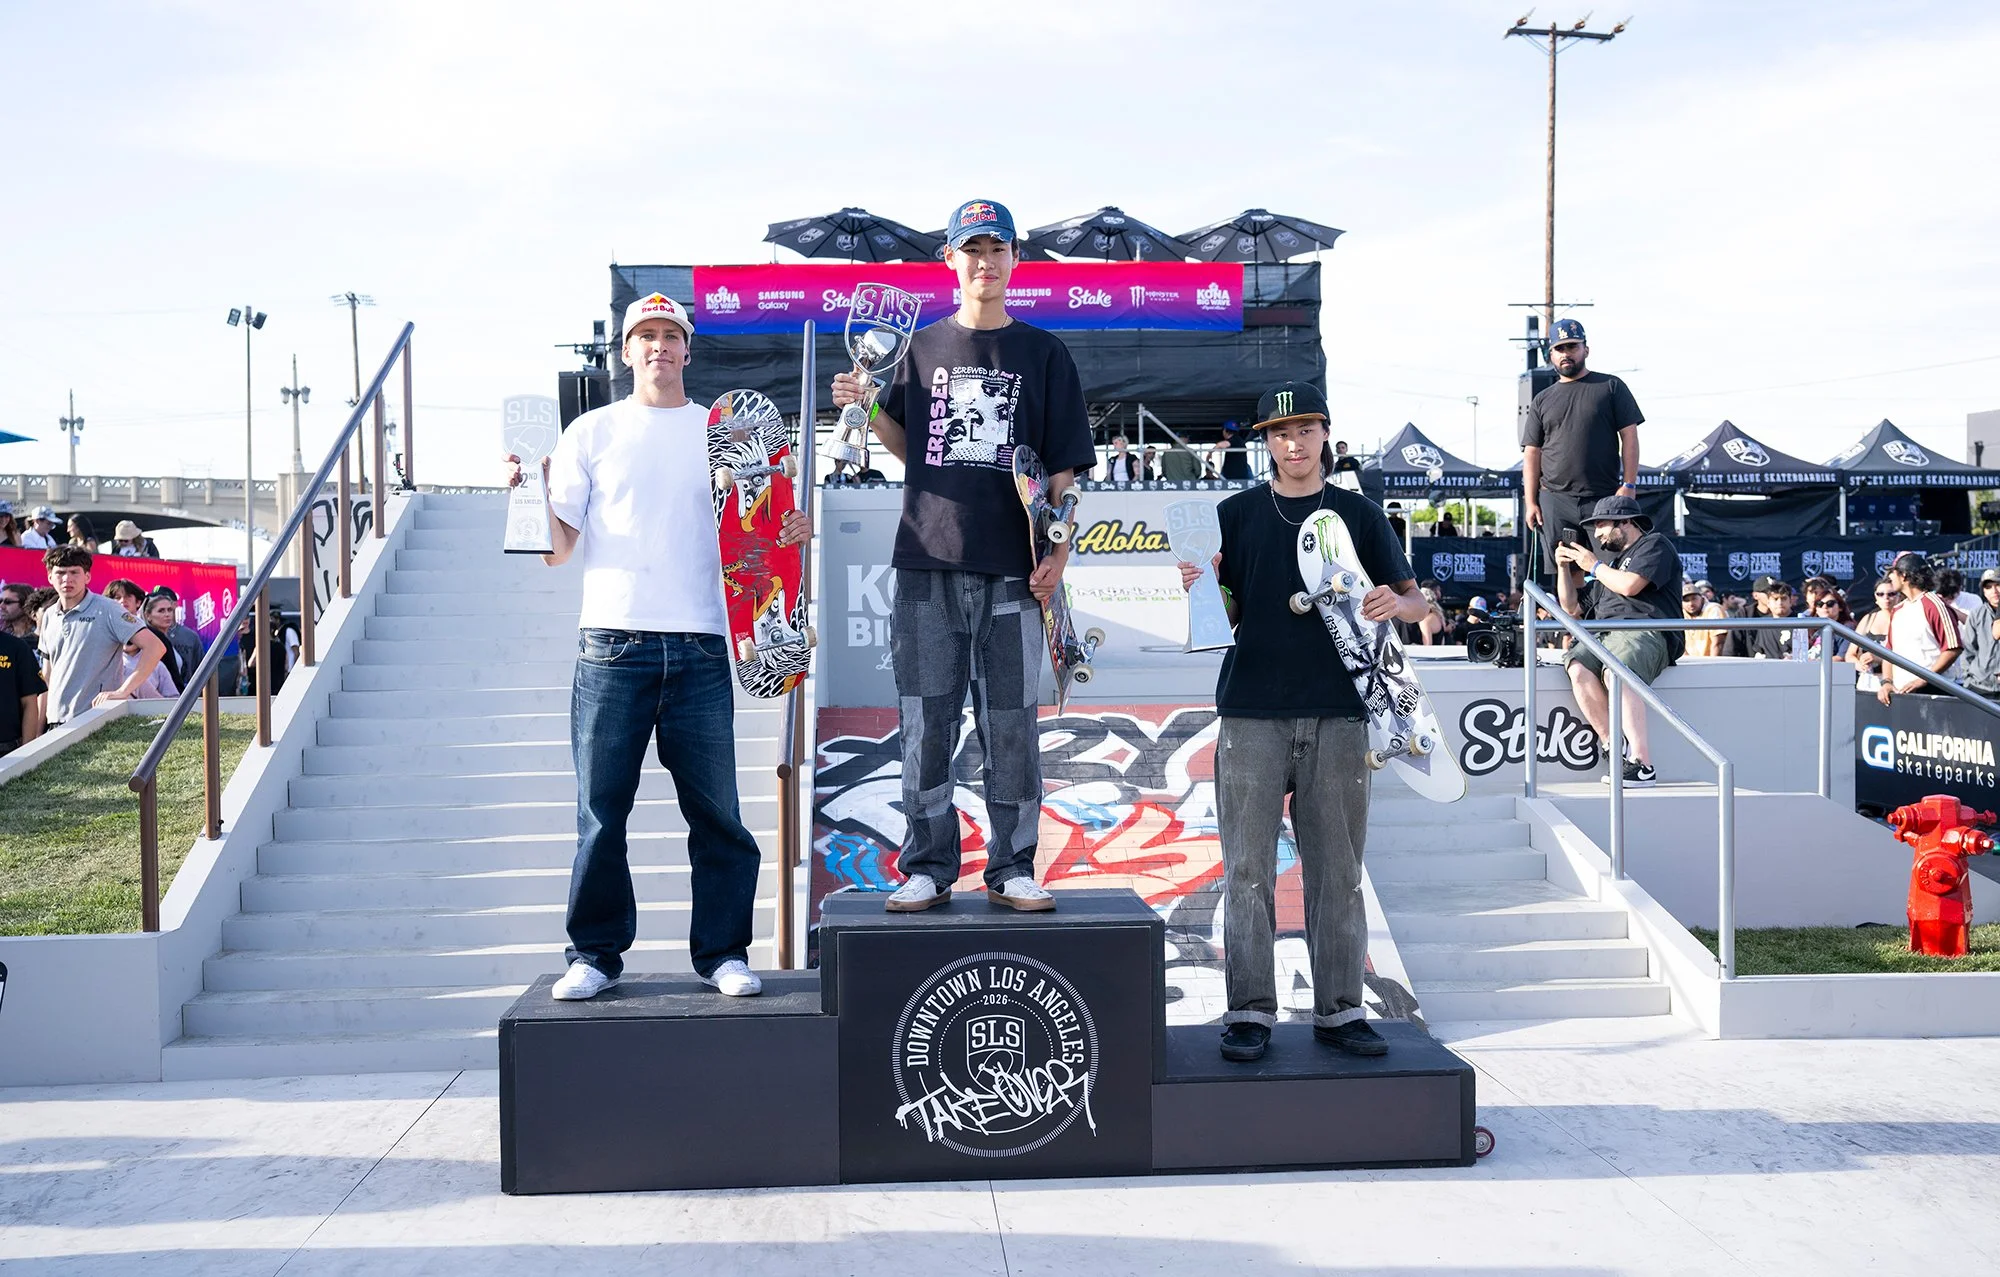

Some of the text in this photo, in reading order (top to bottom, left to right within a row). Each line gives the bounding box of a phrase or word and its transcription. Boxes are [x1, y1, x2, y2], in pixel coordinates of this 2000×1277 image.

[961, 212, 997, 226] Red Bull
[705, 293, 740, 304] KONA
[757, 290, 806, 300] SAMSUNG
[1005, 288, 1052, 297] SAMSUNG
[1068, 286, 1112, 309] Stake
[1196, 289, 1230, 300] KONA
[757, 301, 790, 311] Galaxy
[855, 287, 917, 331] SLS
[1005, 298, 1037, 308] Galaxy
[641, 304, 676, 315] Red Bull
[952, 366, 988, 376] SCREWED
[988, 368, 999, 377] UP
[506, 400, 553, 424] SLS
[925, 366, 949, 467] ERASED
[1393, 476, 1430, 486] LEAGUE
[1726, 473, 1761, 484] LEAGUE
[1763, 473, 1837, 484] SKATEBOARDING
[1887, 475, 1923, 486] LEAGUE
[1925, 475, 2000, 487] SKATEBOARDING
[1170, 503, 1214, 530] SLS
[1433, 554, 1453, 566] SLS
[1454, 553, 1486, 564] STREET
[1729, 552, 1749, 564] SLS
[1750, 552, 1782, 563] STREET
[1803, 551, 1823, 563] SLS
[1824, 551, 1855, 562] STREET
[1454, 564, 1486, 575] LEAGUE
[1681, 563, 1709, 574] EAGUE
[1750, 562, 1782, 573] LEAGUE
[1824, 561, 1855, 572] LEAGUE
[847, 617, 891, 647] BI
[1395, 686, 1419, 719] JESSUP
[1895, 729, 1996, 767] CALIFORNIA
[1896, 756, 1996, 788] skateparks
[982, 993, 1008, 1006] 2026
[906, 966, 1085, 1067] DOWNTOWN LOS ANGELES
[971, 1019, 1021, 1049] SLS
[895, 1059, 1097, 1143] TAKEOVER
